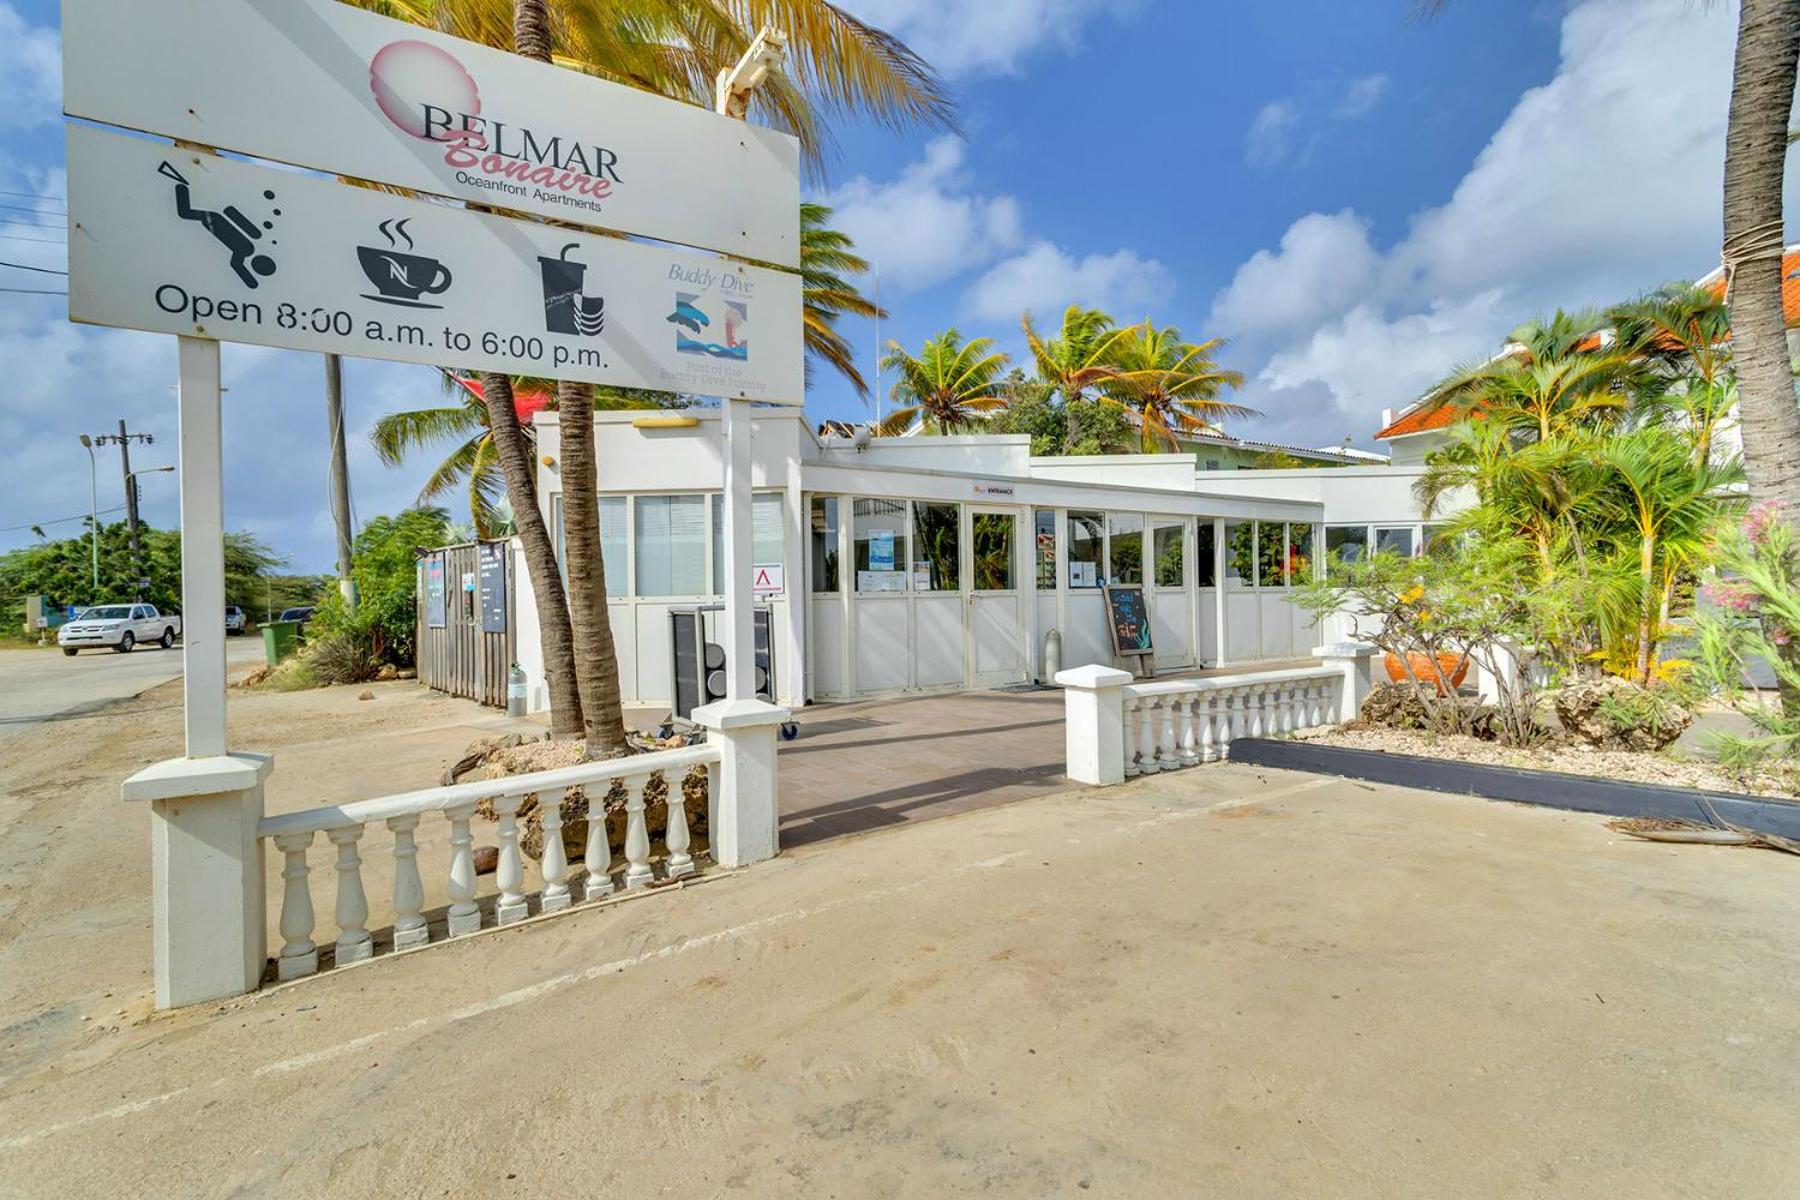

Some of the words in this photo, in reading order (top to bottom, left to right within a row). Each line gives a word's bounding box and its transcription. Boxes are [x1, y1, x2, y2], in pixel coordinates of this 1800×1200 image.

[419, 103, 624, 184] BELMAR
[443, 130, 614, 199] Bonaire
[455, 171, 527, 196] Oceanfront
[533, 186, 602, 212] Apartments
[668, 263, 717, 292] Buddy
[721, 273, 755, 294] Dive
[155, 284, 262, 325] Open
[276, 302, 352, 336] 8:00
[365, 320, 433, 347] a.m.
[443, 326, 471, 351] to
[482, 331, 543, 360] 6:00
[553, 345, 609, 368] p.m.
[660, 368, 697, 385] Buddy
[701, 373, 726, 386] Dive
[728, 376, 767, 392] Family
